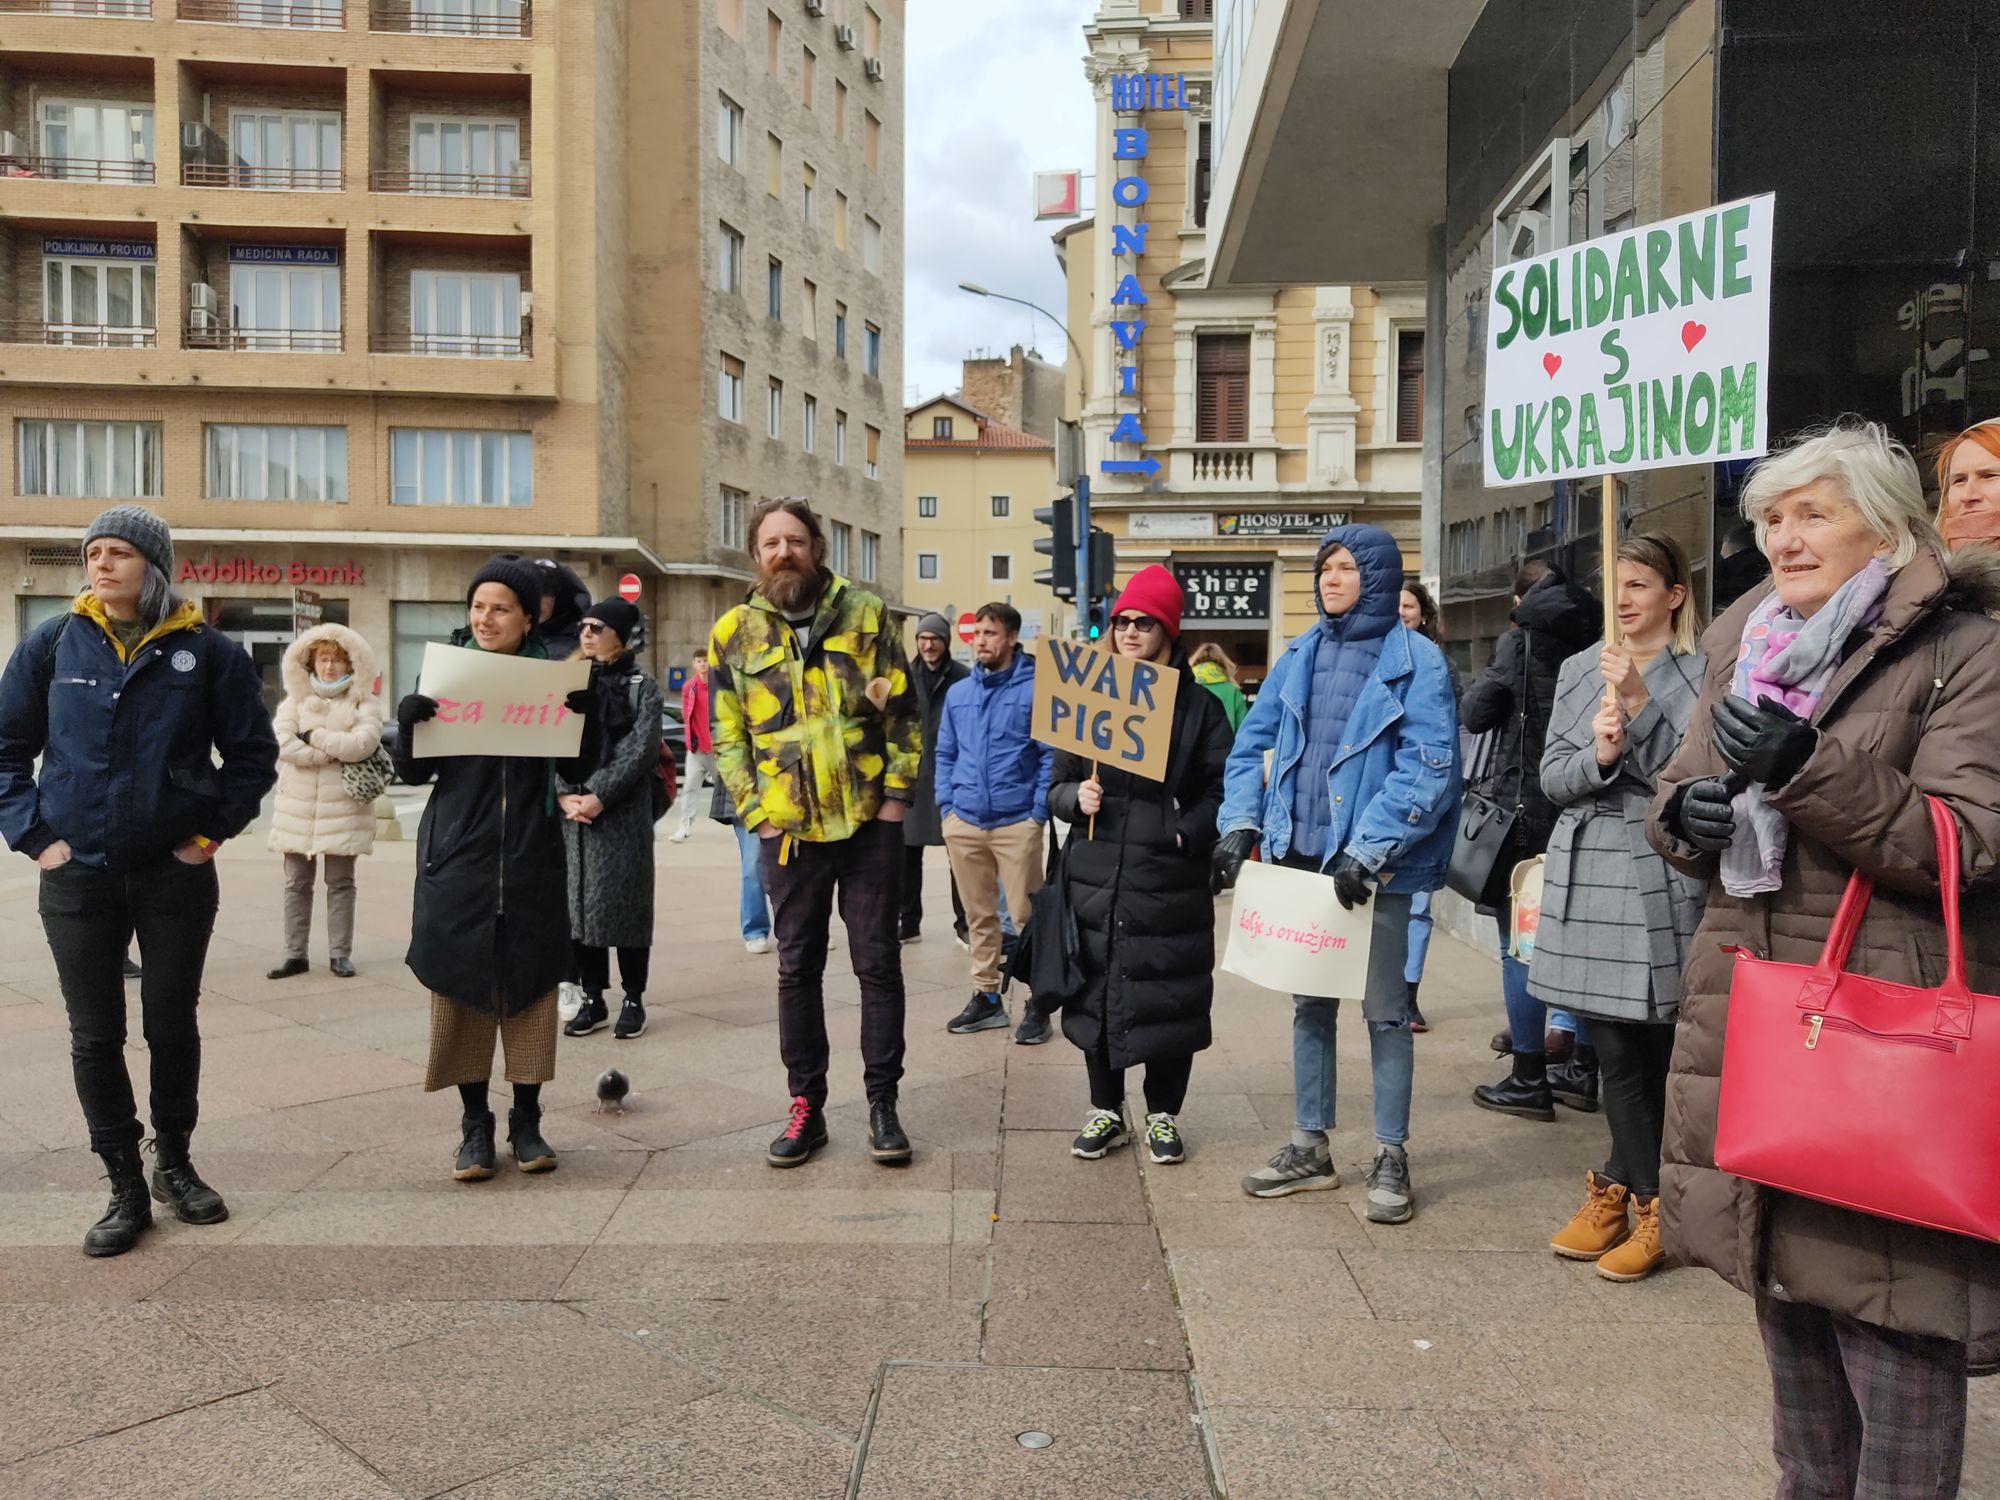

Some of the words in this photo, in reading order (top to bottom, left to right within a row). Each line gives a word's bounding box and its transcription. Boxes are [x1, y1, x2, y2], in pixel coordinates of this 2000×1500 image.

[1111, 72, 1191, 112] HOTEL
[45, 241, 106, 254] POLIKLINIKA
[235, 247, 292, 260] MEDICINA
[297, 249, 330, 262] RADA
[1110, 127, 1149, 443] BONAVIA
[1494, 204, 1753, 350] SOLIDARNE
[1600, 328, 1630, 385] S
[1491, 361, 1757, 481] UKRAJINOM
[178, 559, 282, 584] Addiko
[287, 560, 365, 585] Bank
[1187, 574, 1259, 593] shoe
[1195, 592, 1250, 610] box
[1048, 639, 1159, 712] WAR
[436, 697, 485, 724] za
[502, 691, 568, 727] mir
[1050, 695, 1147, 762] PIGS
[1265, 924, 1275, 937] s
[1276, 921, 1347, 954] oružjem
